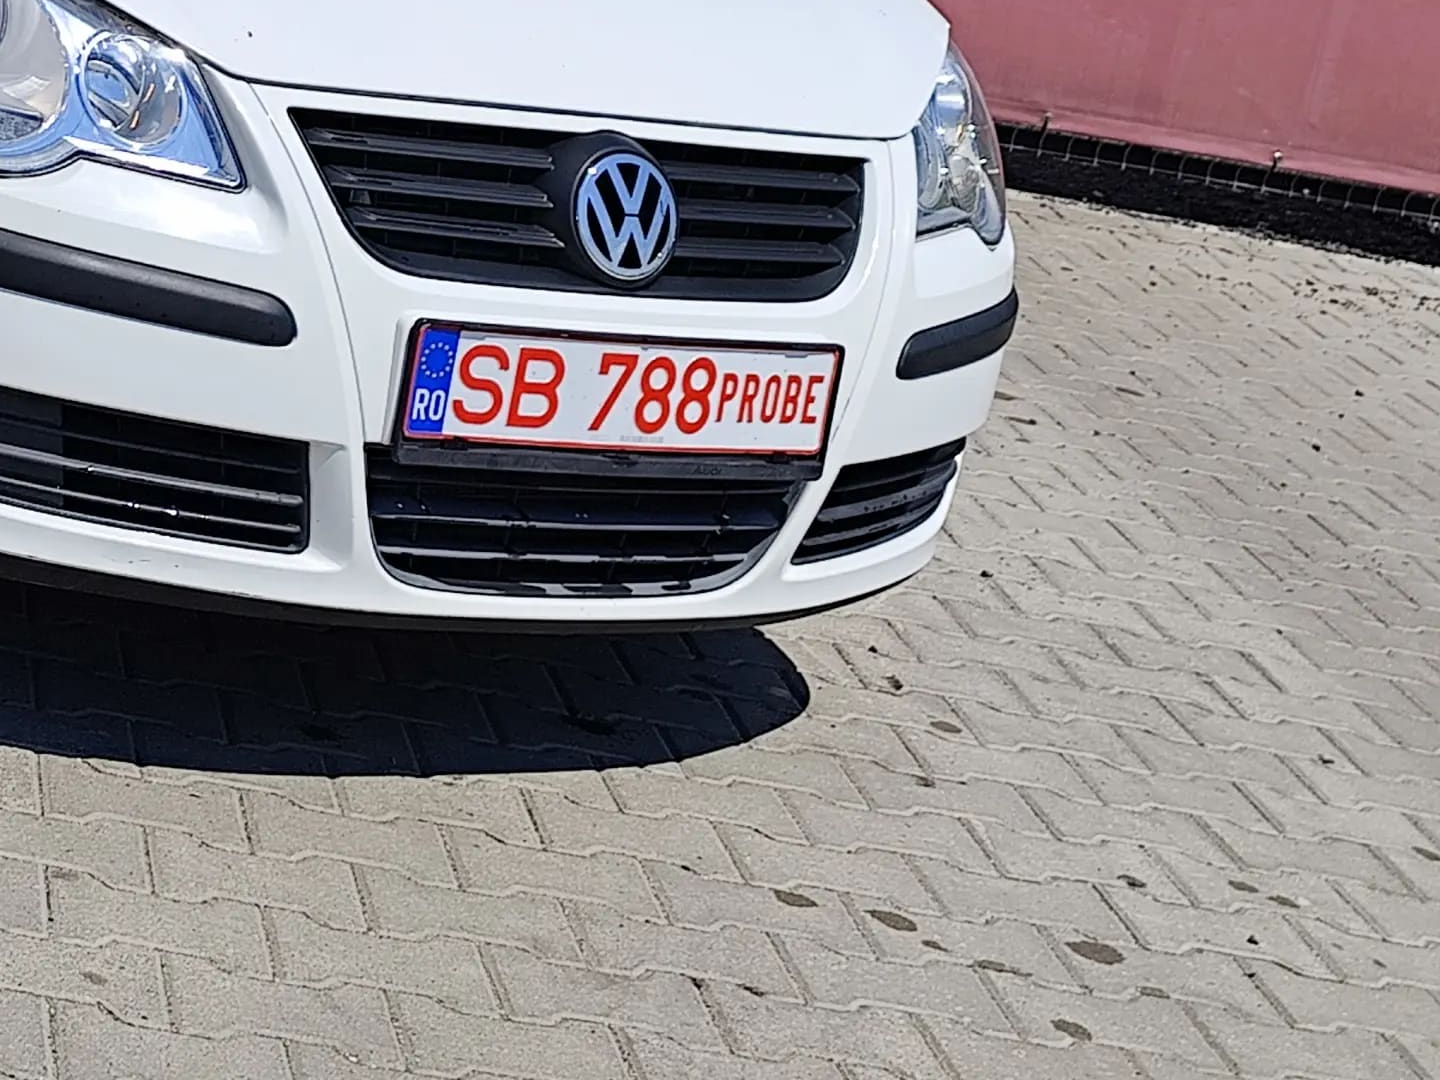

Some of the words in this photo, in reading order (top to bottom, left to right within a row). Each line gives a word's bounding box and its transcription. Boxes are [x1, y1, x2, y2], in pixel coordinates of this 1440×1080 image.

[576, 152, 678, 280] VW
[411, 387, 447, 421] RO
[452, 344, 566, 428] SB
[589, 353, 717, 434] 788
[716, 372, 824, 424] PROBE
